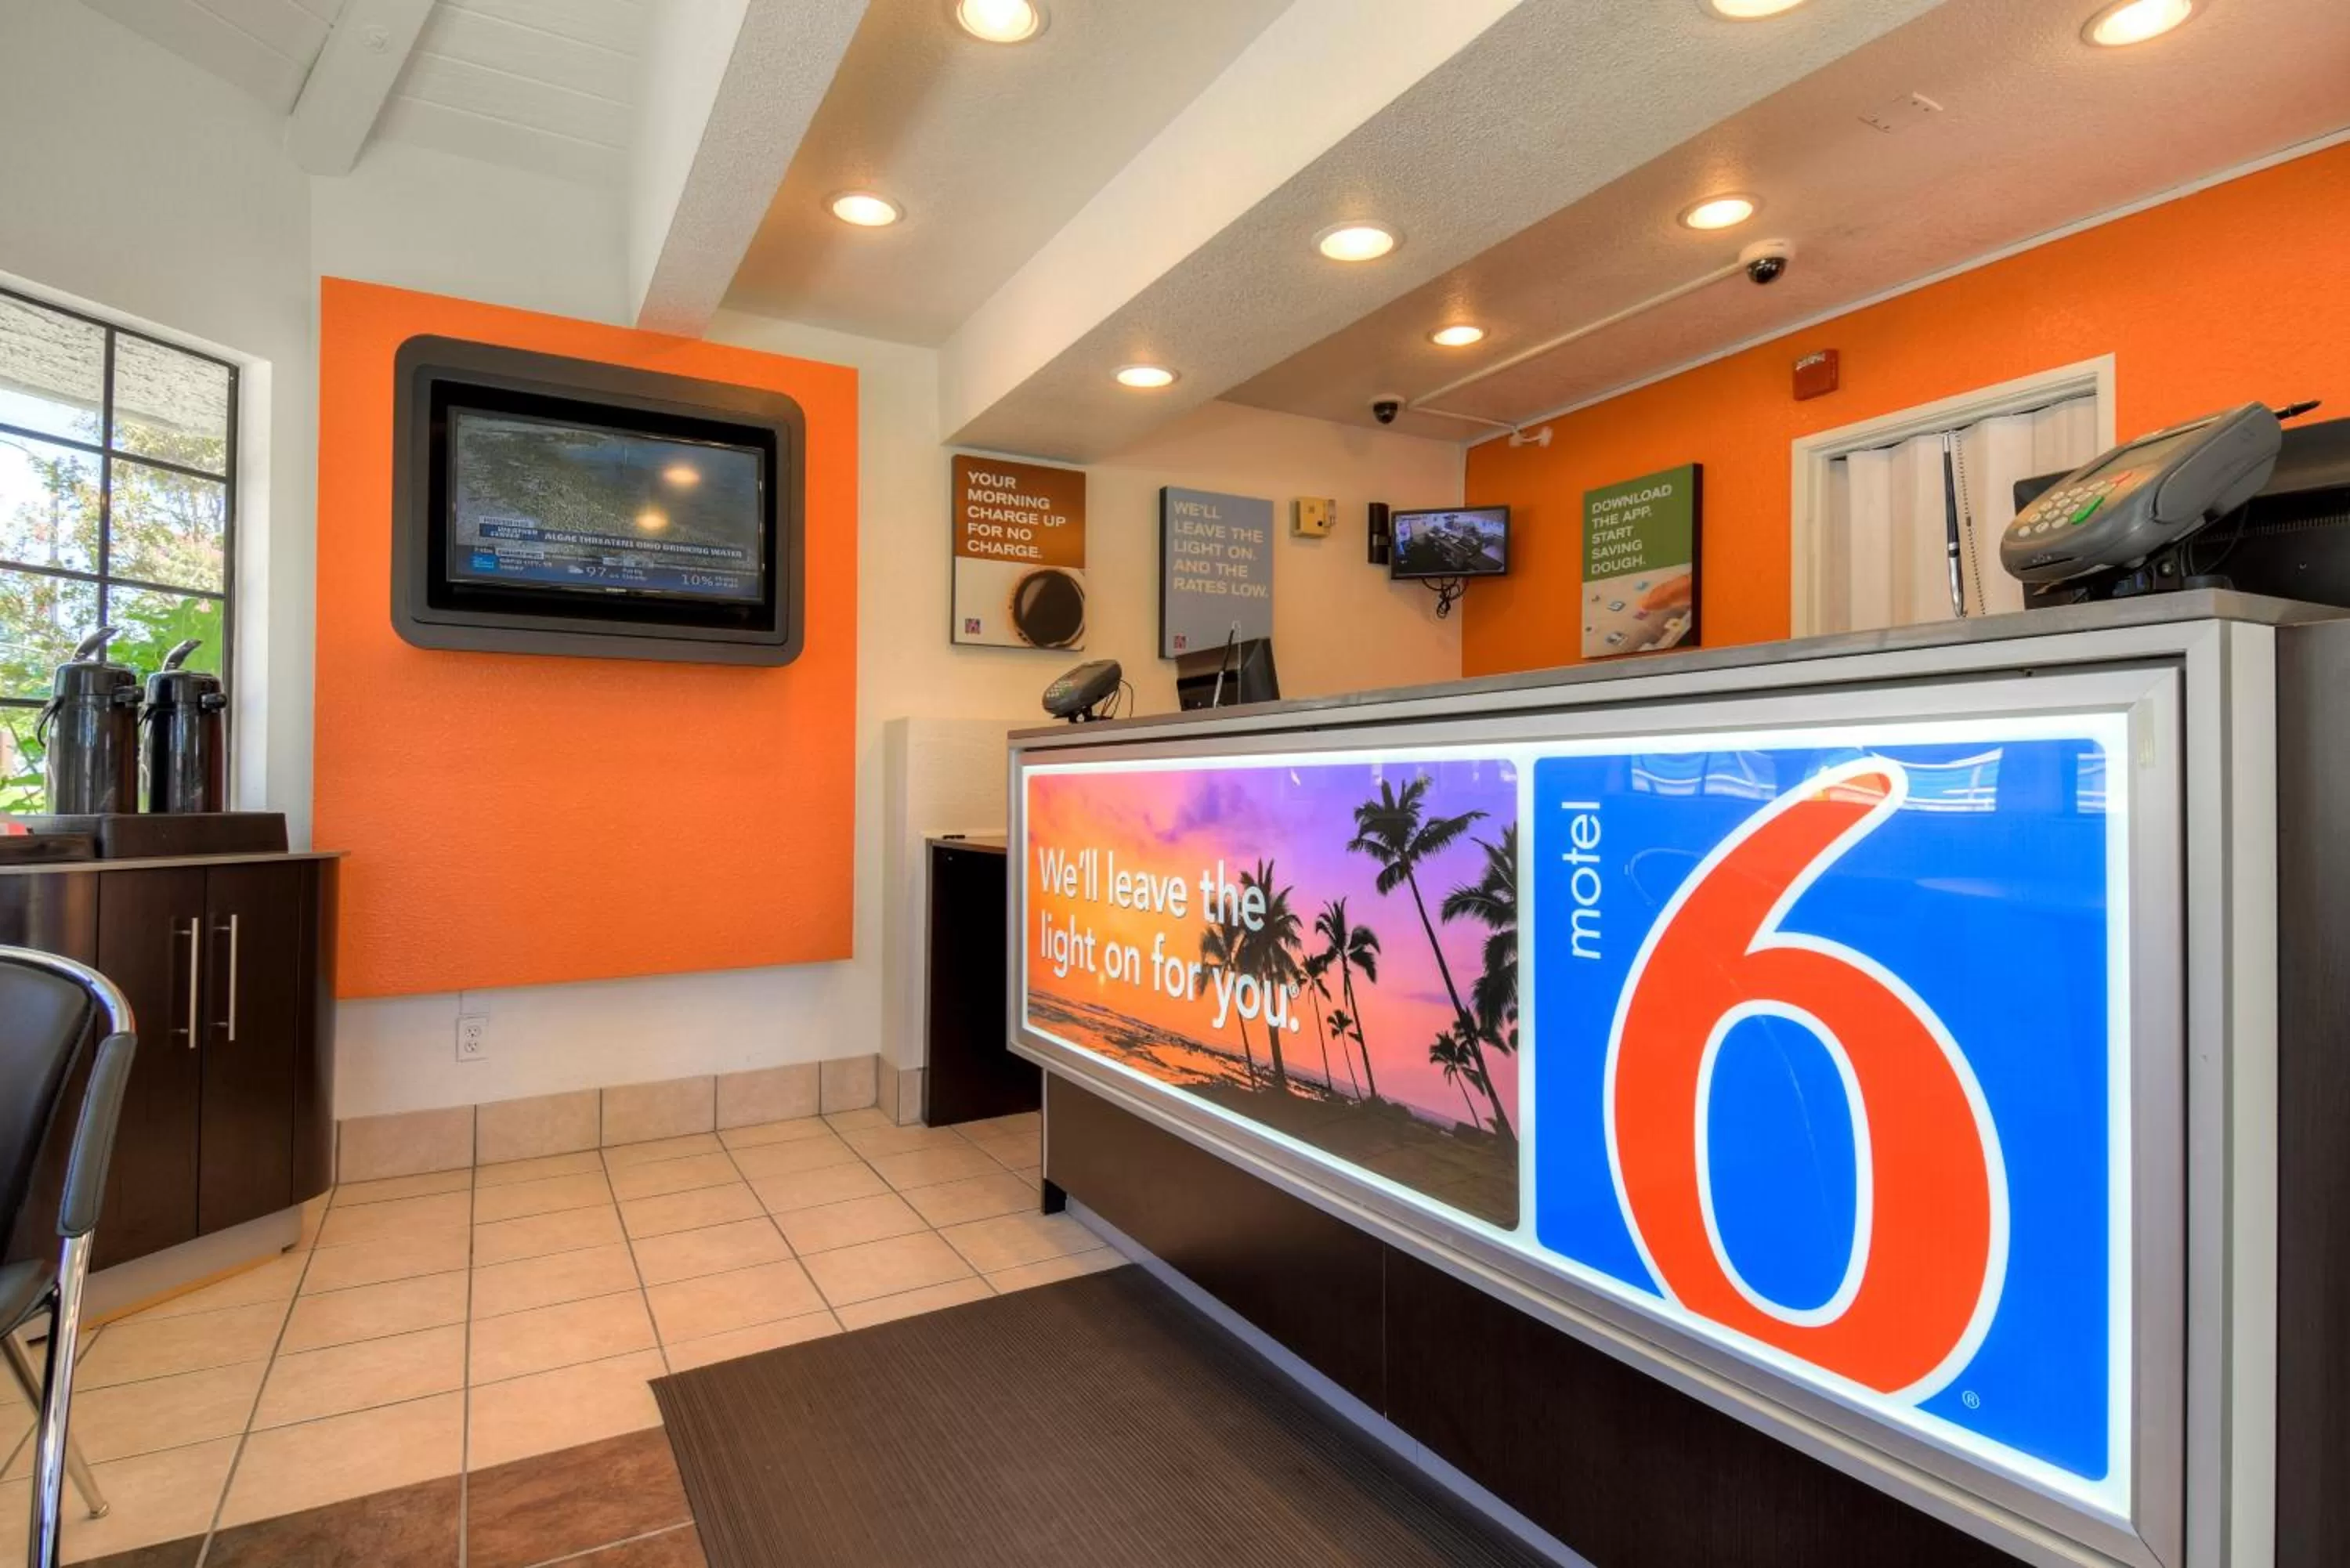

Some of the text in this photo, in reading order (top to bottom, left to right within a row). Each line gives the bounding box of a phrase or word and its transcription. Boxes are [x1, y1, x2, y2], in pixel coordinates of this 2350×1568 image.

[967, 471, 1016, 490] YOUR
[967, 489, 1050, 510] MORNING
[1592, 484, 1672, 514] DOWNLOAD
[967, 505, 1066, 527] CHARGE UP
[1174, 501, 1222, 519] WE'LL
[1592, 505, 1652, 529] THE APP.
[967, 523, 1032, 541] FOR NO
[1174, 519, 1264, 543] LEAVE THE
[1592, 525, 1634, 544] START
[967, 540, 1043, 559] CHARGE.
[1174, 540, 1258, 561] LIGHT ON.
[1591, 539, 1643, 559] SAVING
[1173, 561, 1248, 577] AND THE
[1591, 555, 1646, 574] DOUGH.
[681, 573, 713, 587] 10%
[1174, 577, 1269, 599] RATES LOW.
[1039, 847, 1267, 931] We'll leave the
[1561, 801, 1602, 960] motel
[1040, 909, 1097, 977] light
[1104, 941, 1141, 985] on
[1151, 932, 1202, 1001] for
[1603, 753, 2010, 1407] 6
